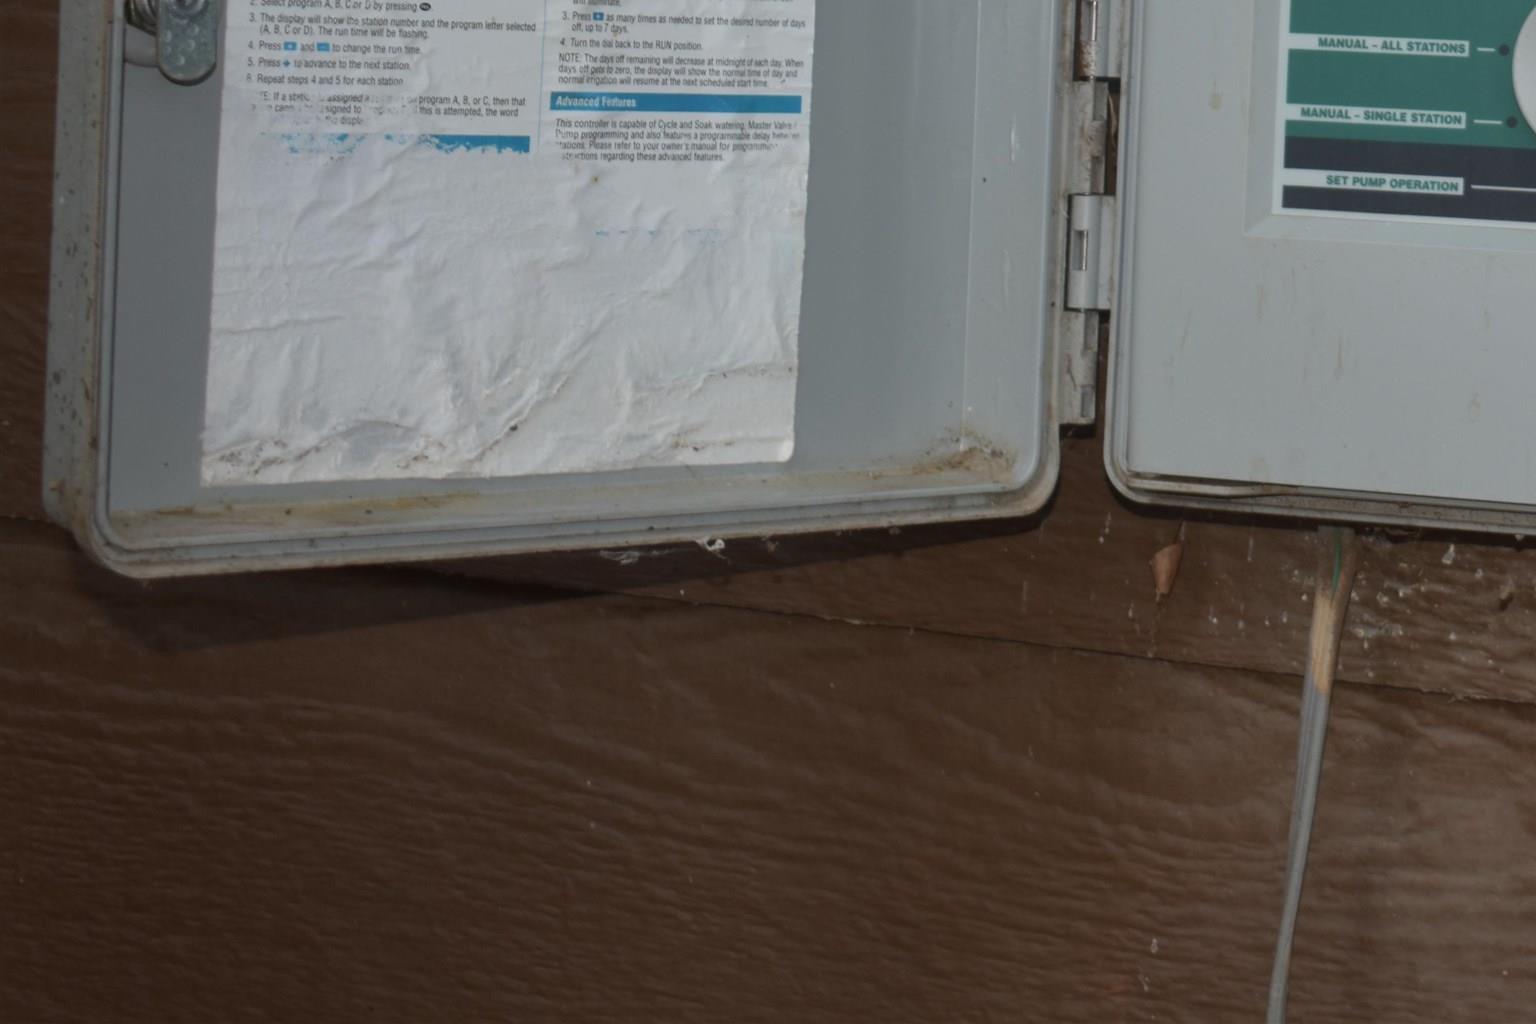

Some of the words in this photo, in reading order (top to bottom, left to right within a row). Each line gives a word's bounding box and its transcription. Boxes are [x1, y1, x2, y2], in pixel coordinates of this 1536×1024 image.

[1318, 37, 1369, 49] MANUAL
[1381, 39, 1403, 51] ALL
[1406, 41, 1466, 54] STATIONS
[555, 95, 599, 106] Advanced
[601, 96, 636, 106] Features
[1300, 107, 1351, 120] MANUAL
[1363, 110, 1407, 122] SINGLE
[1410, 112, 1462, 125] STATION
[1326, 174, 1348, 185] SET
[1352, 176, 1387, 187] PUMP
[1390, 178, 1459, 191] OPERATION
